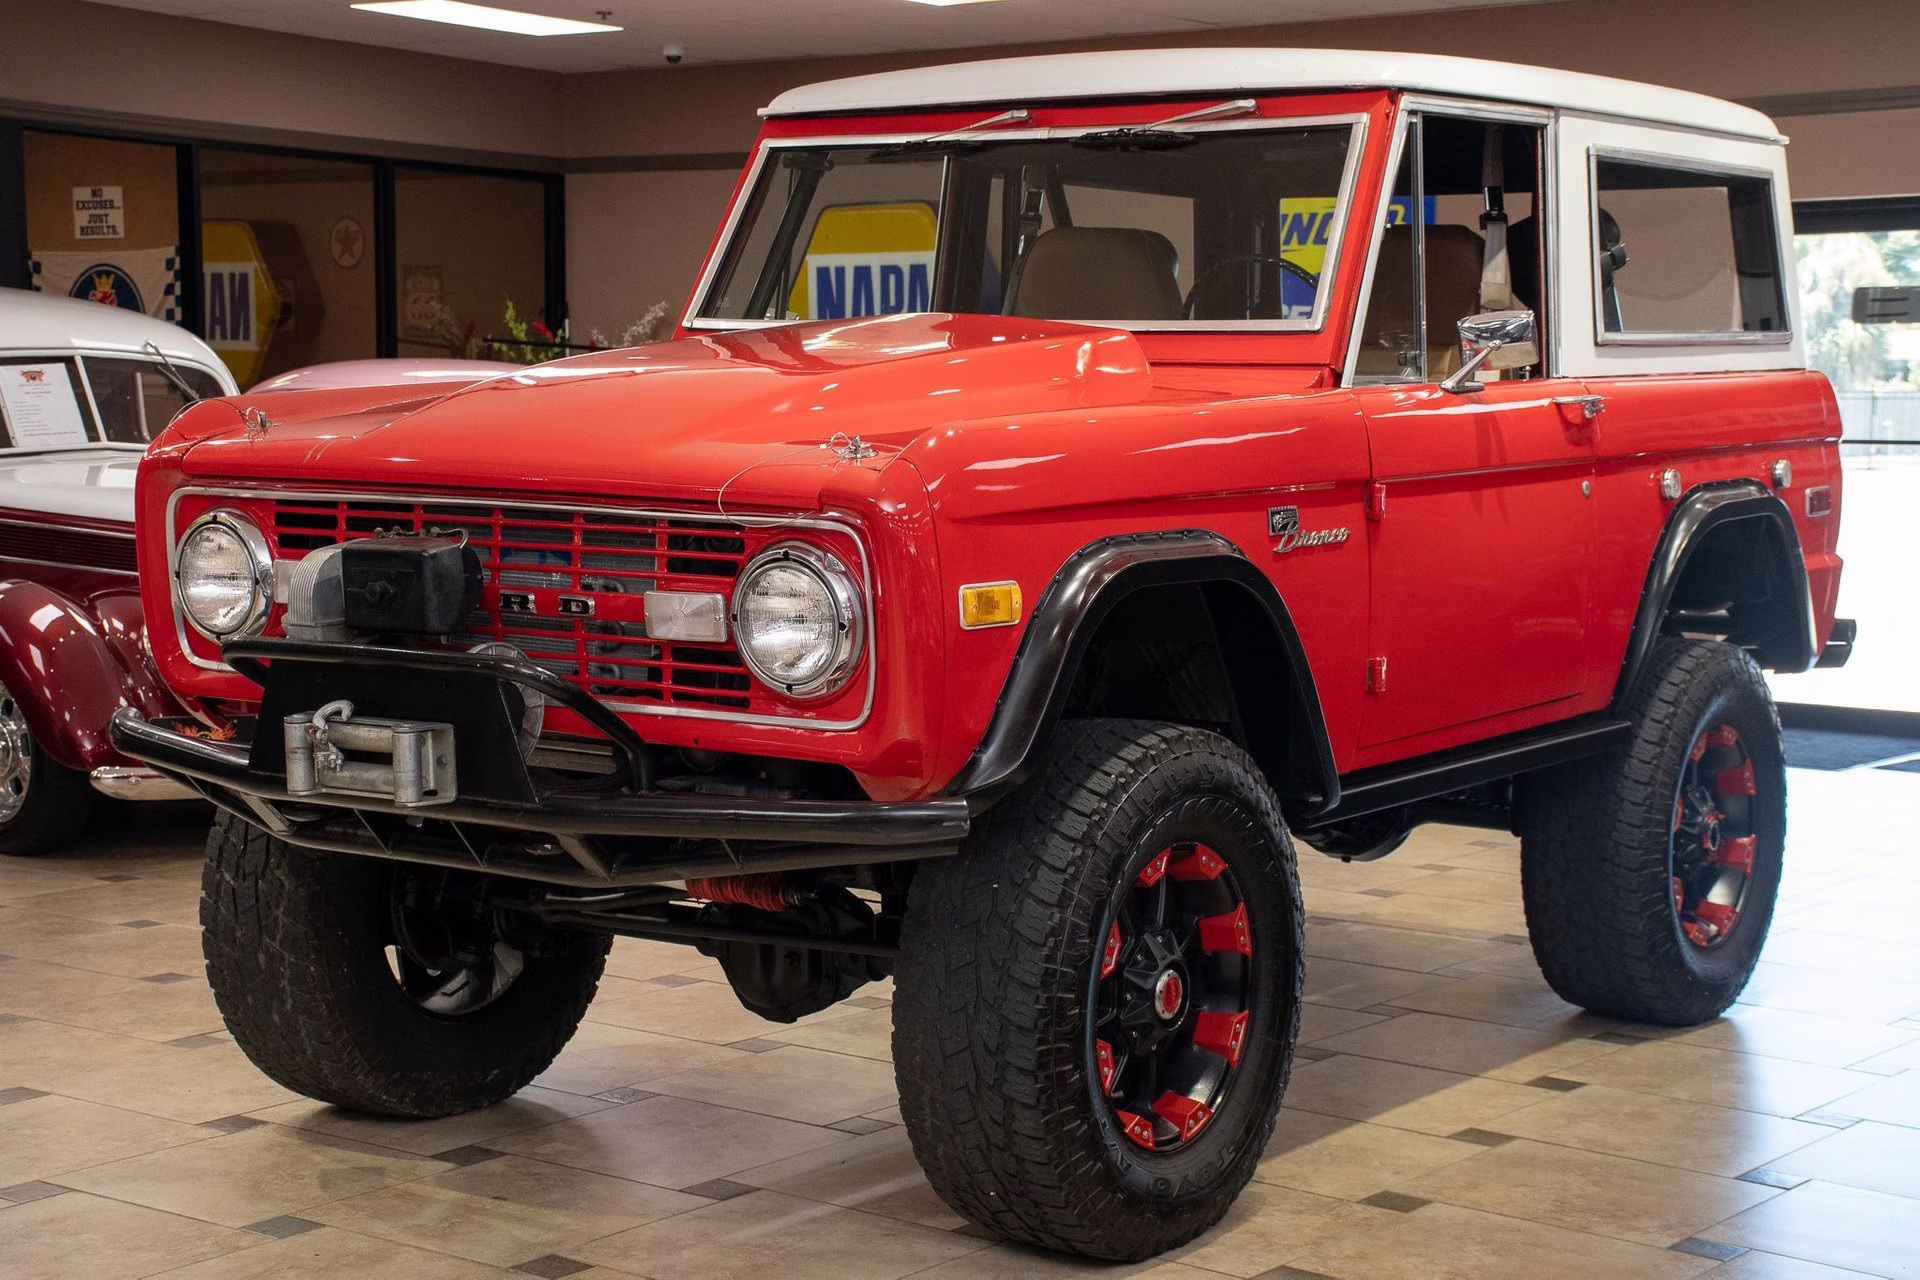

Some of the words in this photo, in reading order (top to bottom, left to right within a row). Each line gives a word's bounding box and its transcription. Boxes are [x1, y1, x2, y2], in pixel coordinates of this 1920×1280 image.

[91, 188, 103, 198] NO
[88, 213, 109, 224] JUST
[816, 263, 931, 320] NAPA
[1273, 519, 1350, 554] Bronco
[499, 590, 595, 617] RD
